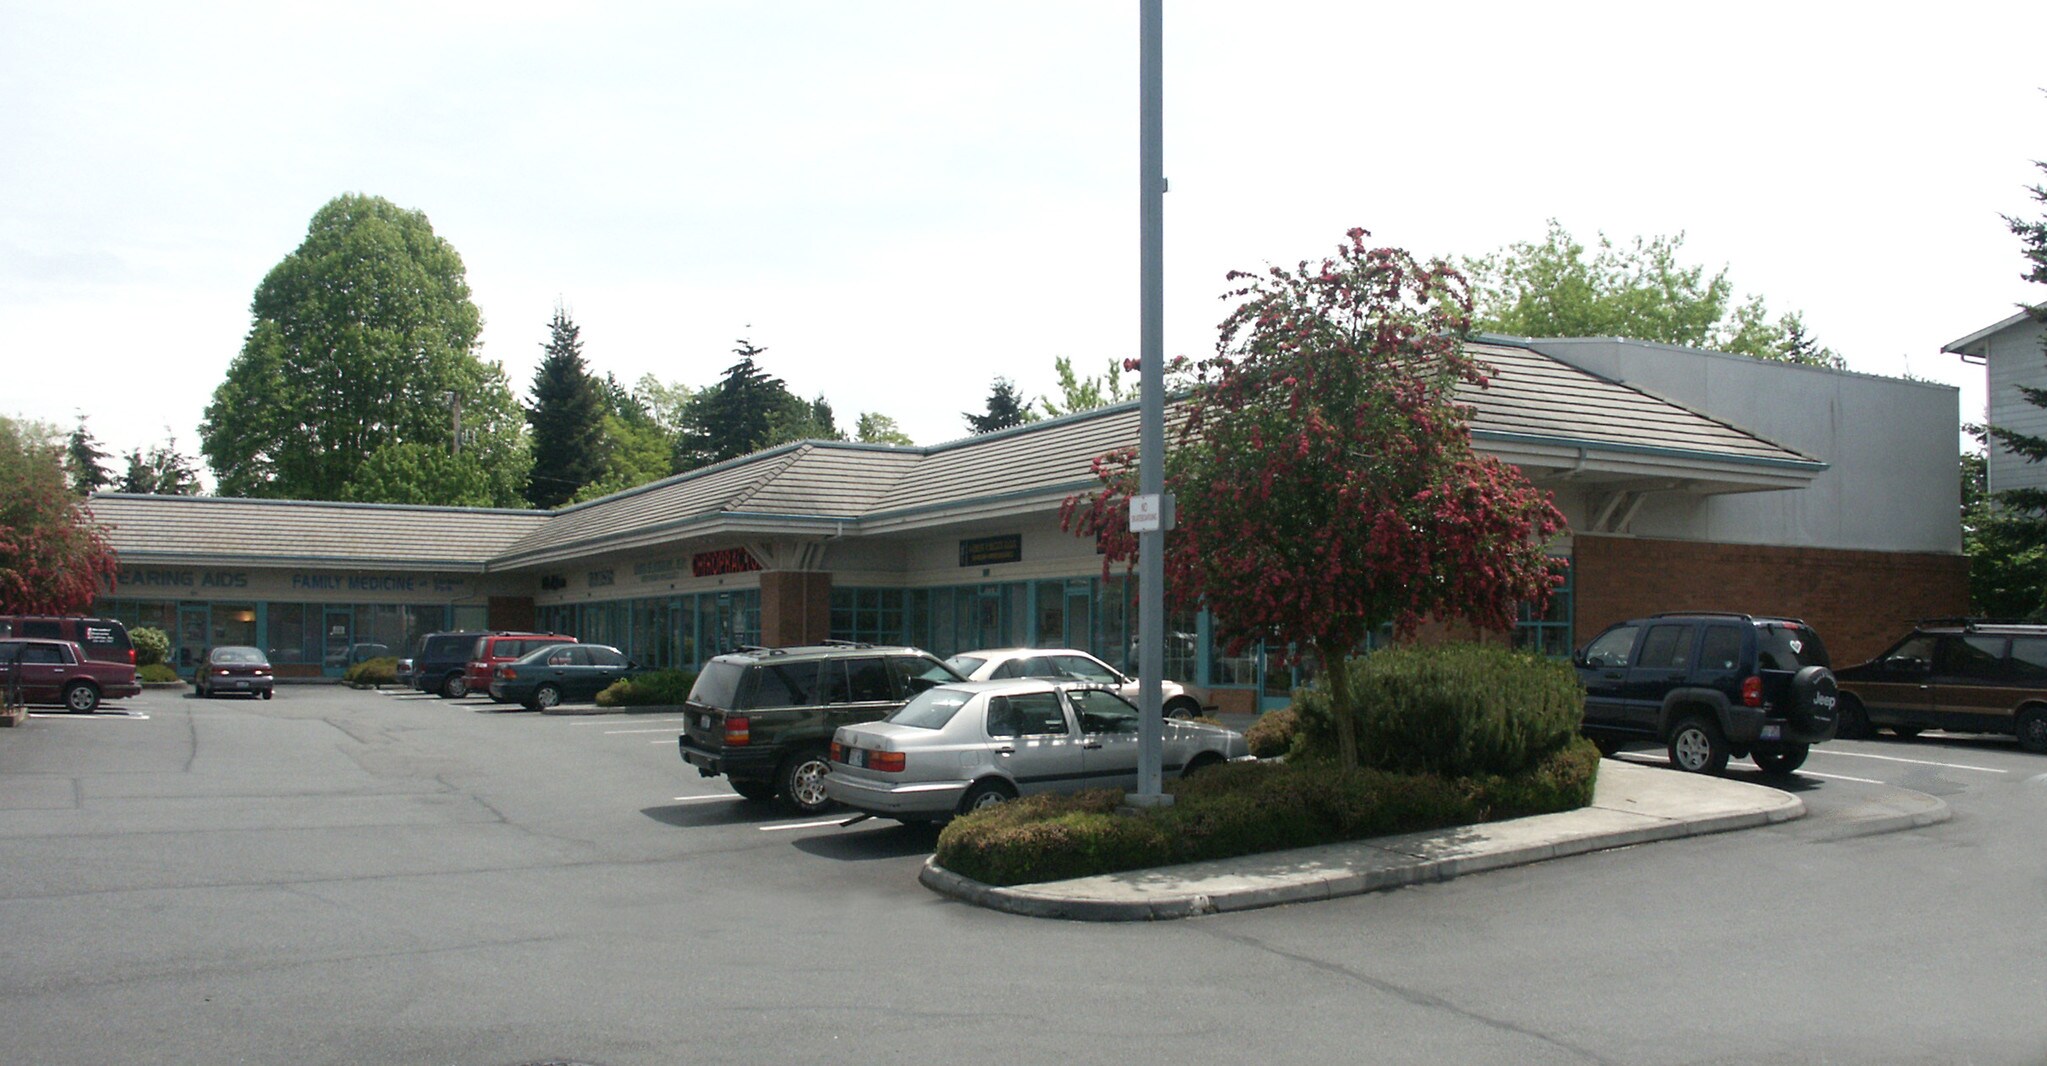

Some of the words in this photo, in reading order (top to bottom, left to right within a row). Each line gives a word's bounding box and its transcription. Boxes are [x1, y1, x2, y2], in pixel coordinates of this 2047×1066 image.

[692, 546, 763, 577] CHIROPRACTO
[201, 571, 248, 588] AIDS
[291, 574, 343, 590] FAMILY
[347, 575, 415, 591] MEDICINE
[1813, 690, 1836, 710] Jeep
